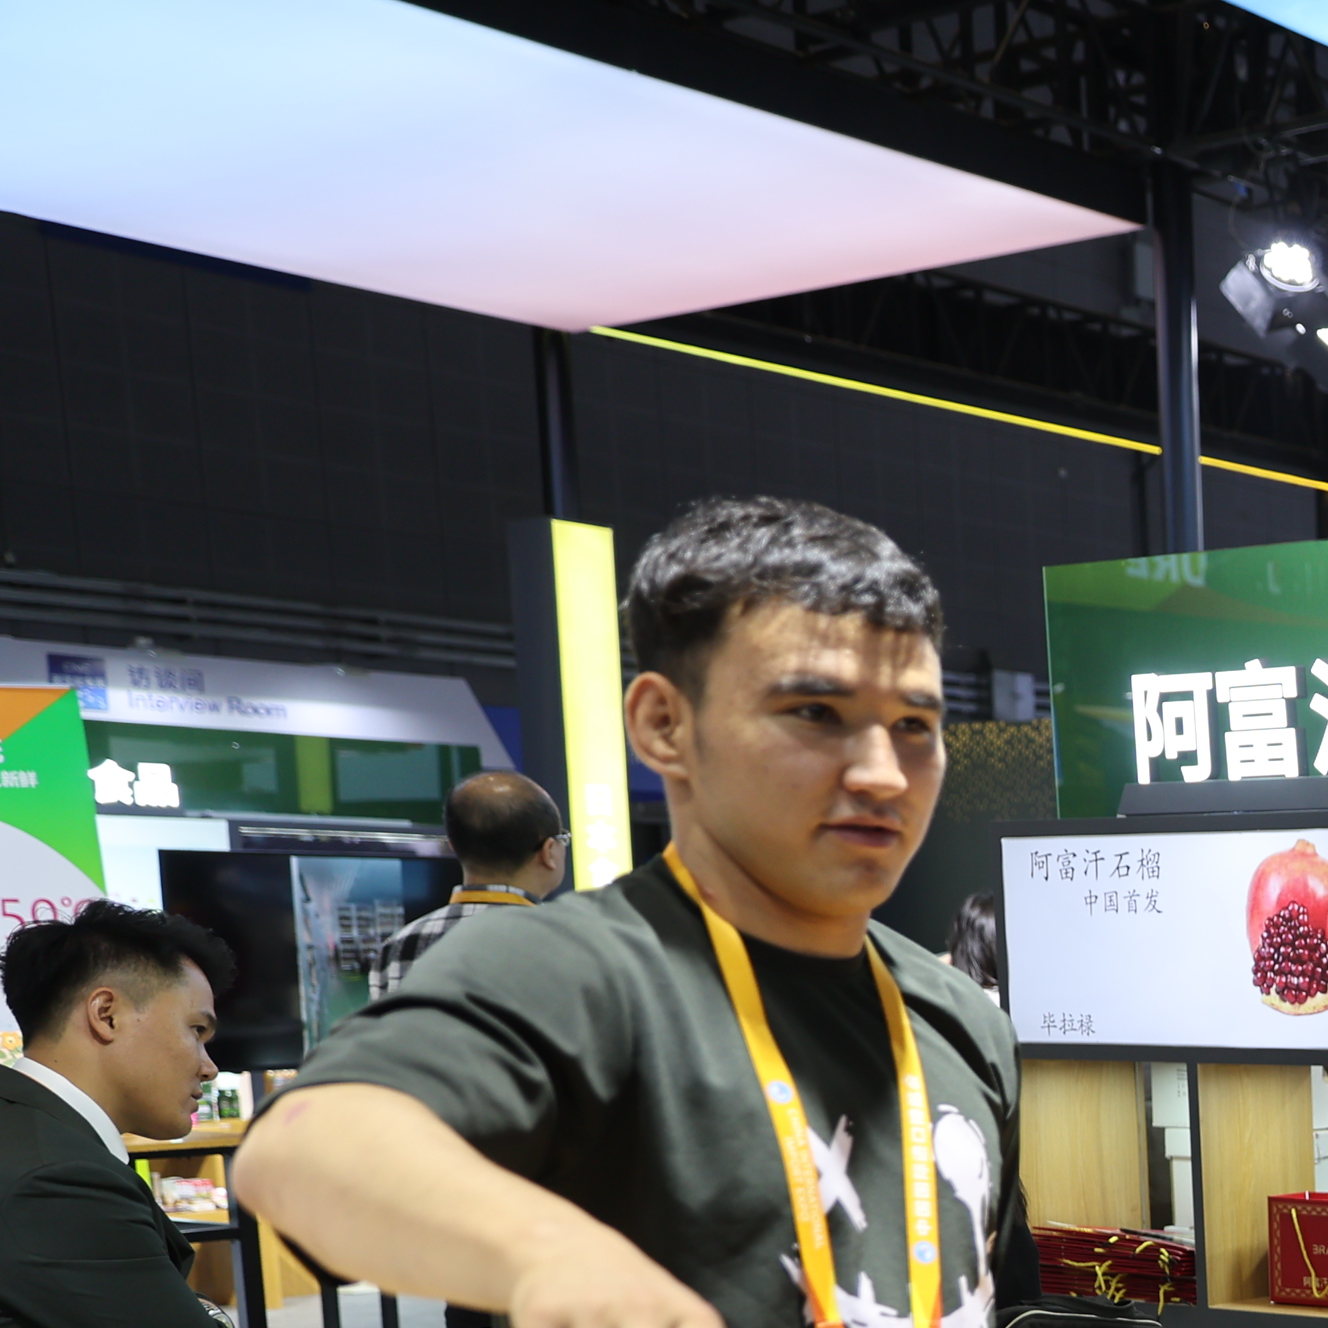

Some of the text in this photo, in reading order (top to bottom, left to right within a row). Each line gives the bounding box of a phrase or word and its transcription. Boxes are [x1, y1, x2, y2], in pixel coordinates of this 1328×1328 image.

[127, 691, 287, 719] Interview Room
[87, 758, 180, 808] 食品
[1030, 848, 1161, 882] 阿富汗石榴
[1084, 889, 1163, 916] 中国首发
[1041, 1011, 1096, 1036] 毕拉禄
[784, 1137, 809, 1222] IMPORT EXPO
[800, 1150, 825, 1249] INTERNATIONAL
